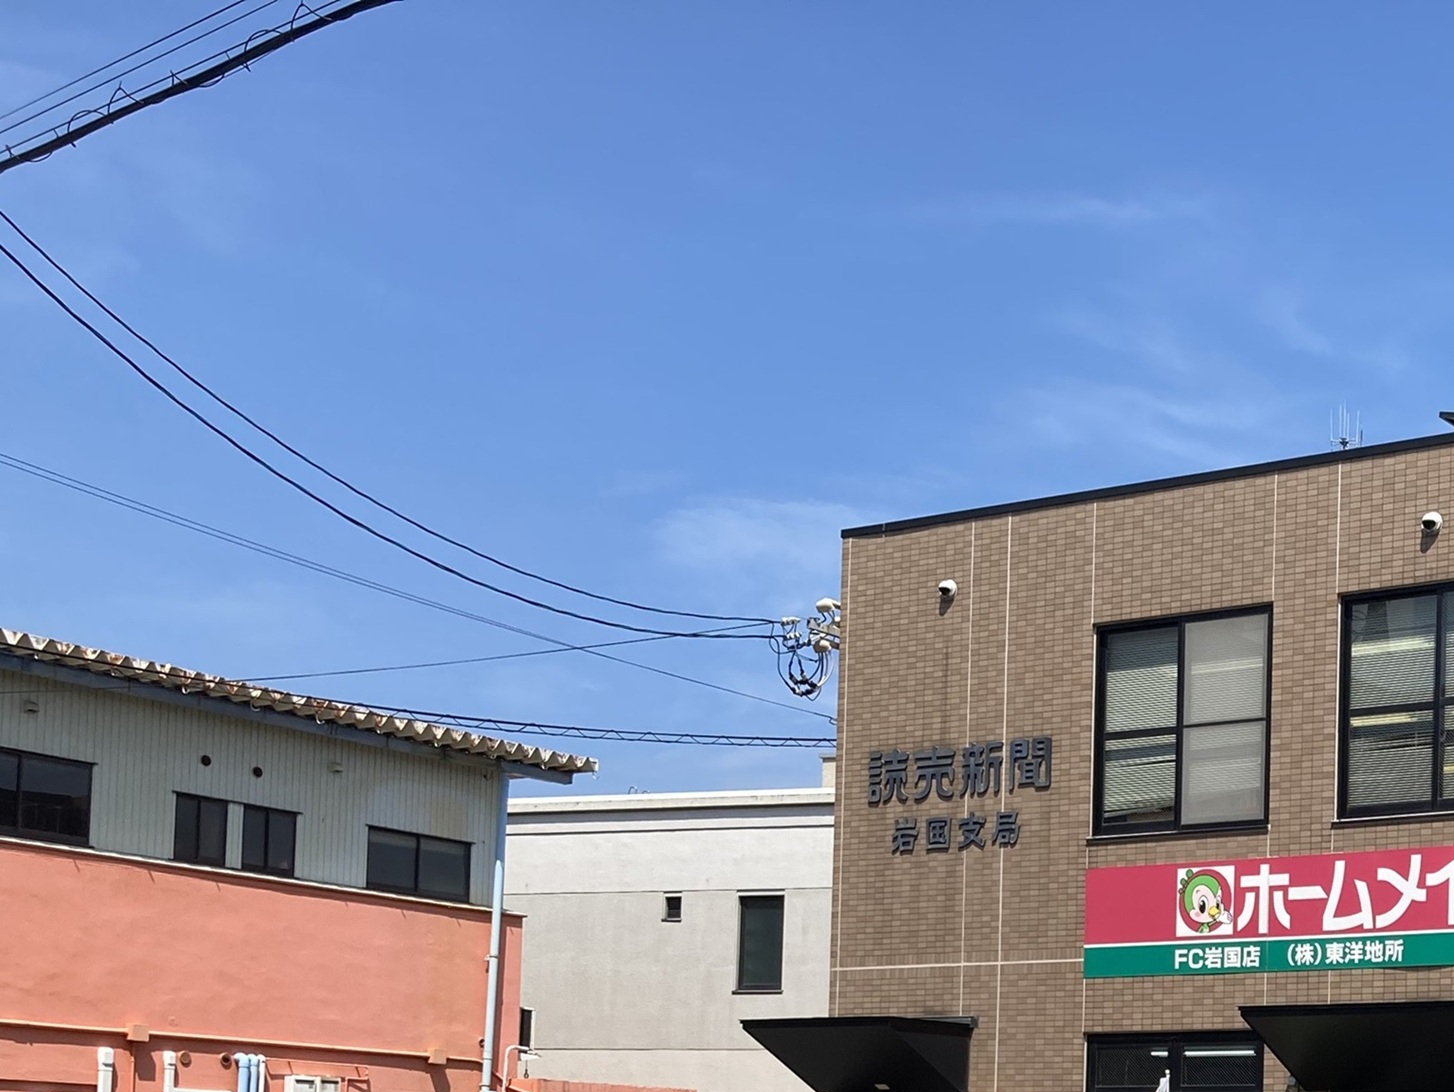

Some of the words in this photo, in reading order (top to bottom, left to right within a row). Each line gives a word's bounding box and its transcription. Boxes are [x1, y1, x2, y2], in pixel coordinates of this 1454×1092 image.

[867, 736, 1052, 806] 読売新聞
[891, 811, 1020, 854] 岩国支局
[1174, 946, 1261, 970] FC岩国店
[1287, 939, 1404, 967] (株)東洋地所
